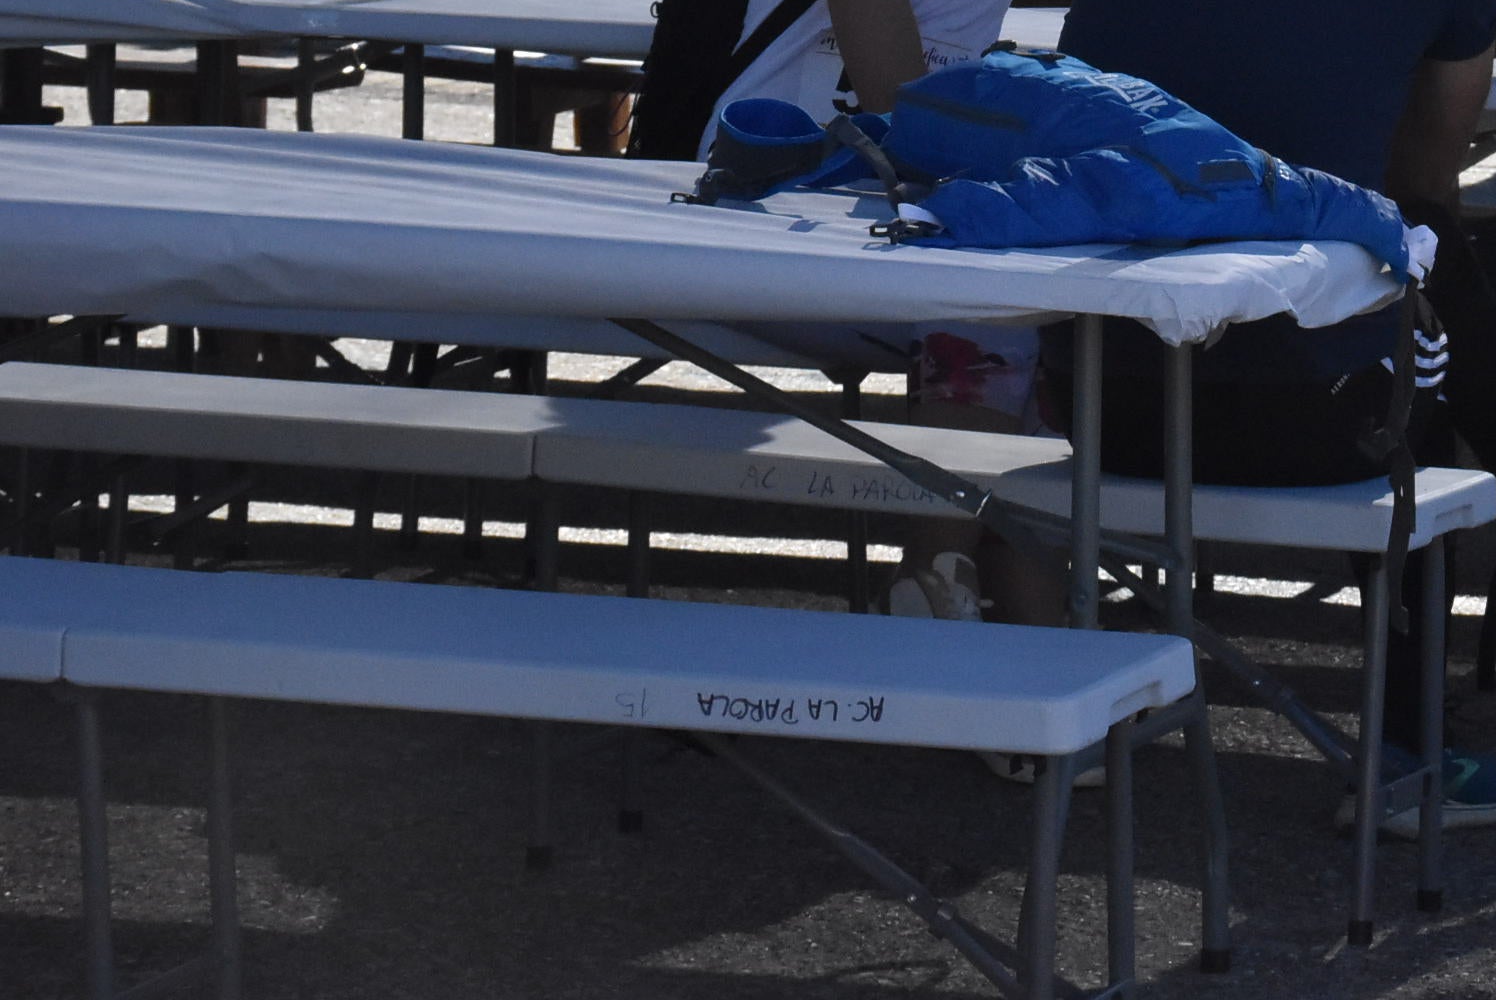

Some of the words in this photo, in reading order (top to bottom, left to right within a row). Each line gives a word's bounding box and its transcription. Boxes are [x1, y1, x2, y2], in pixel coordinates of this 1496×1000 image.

[807, 471, 835, 498] LA
[697, 692, 799, 725] PAROLA
[808, 698, 838, 722] LA
